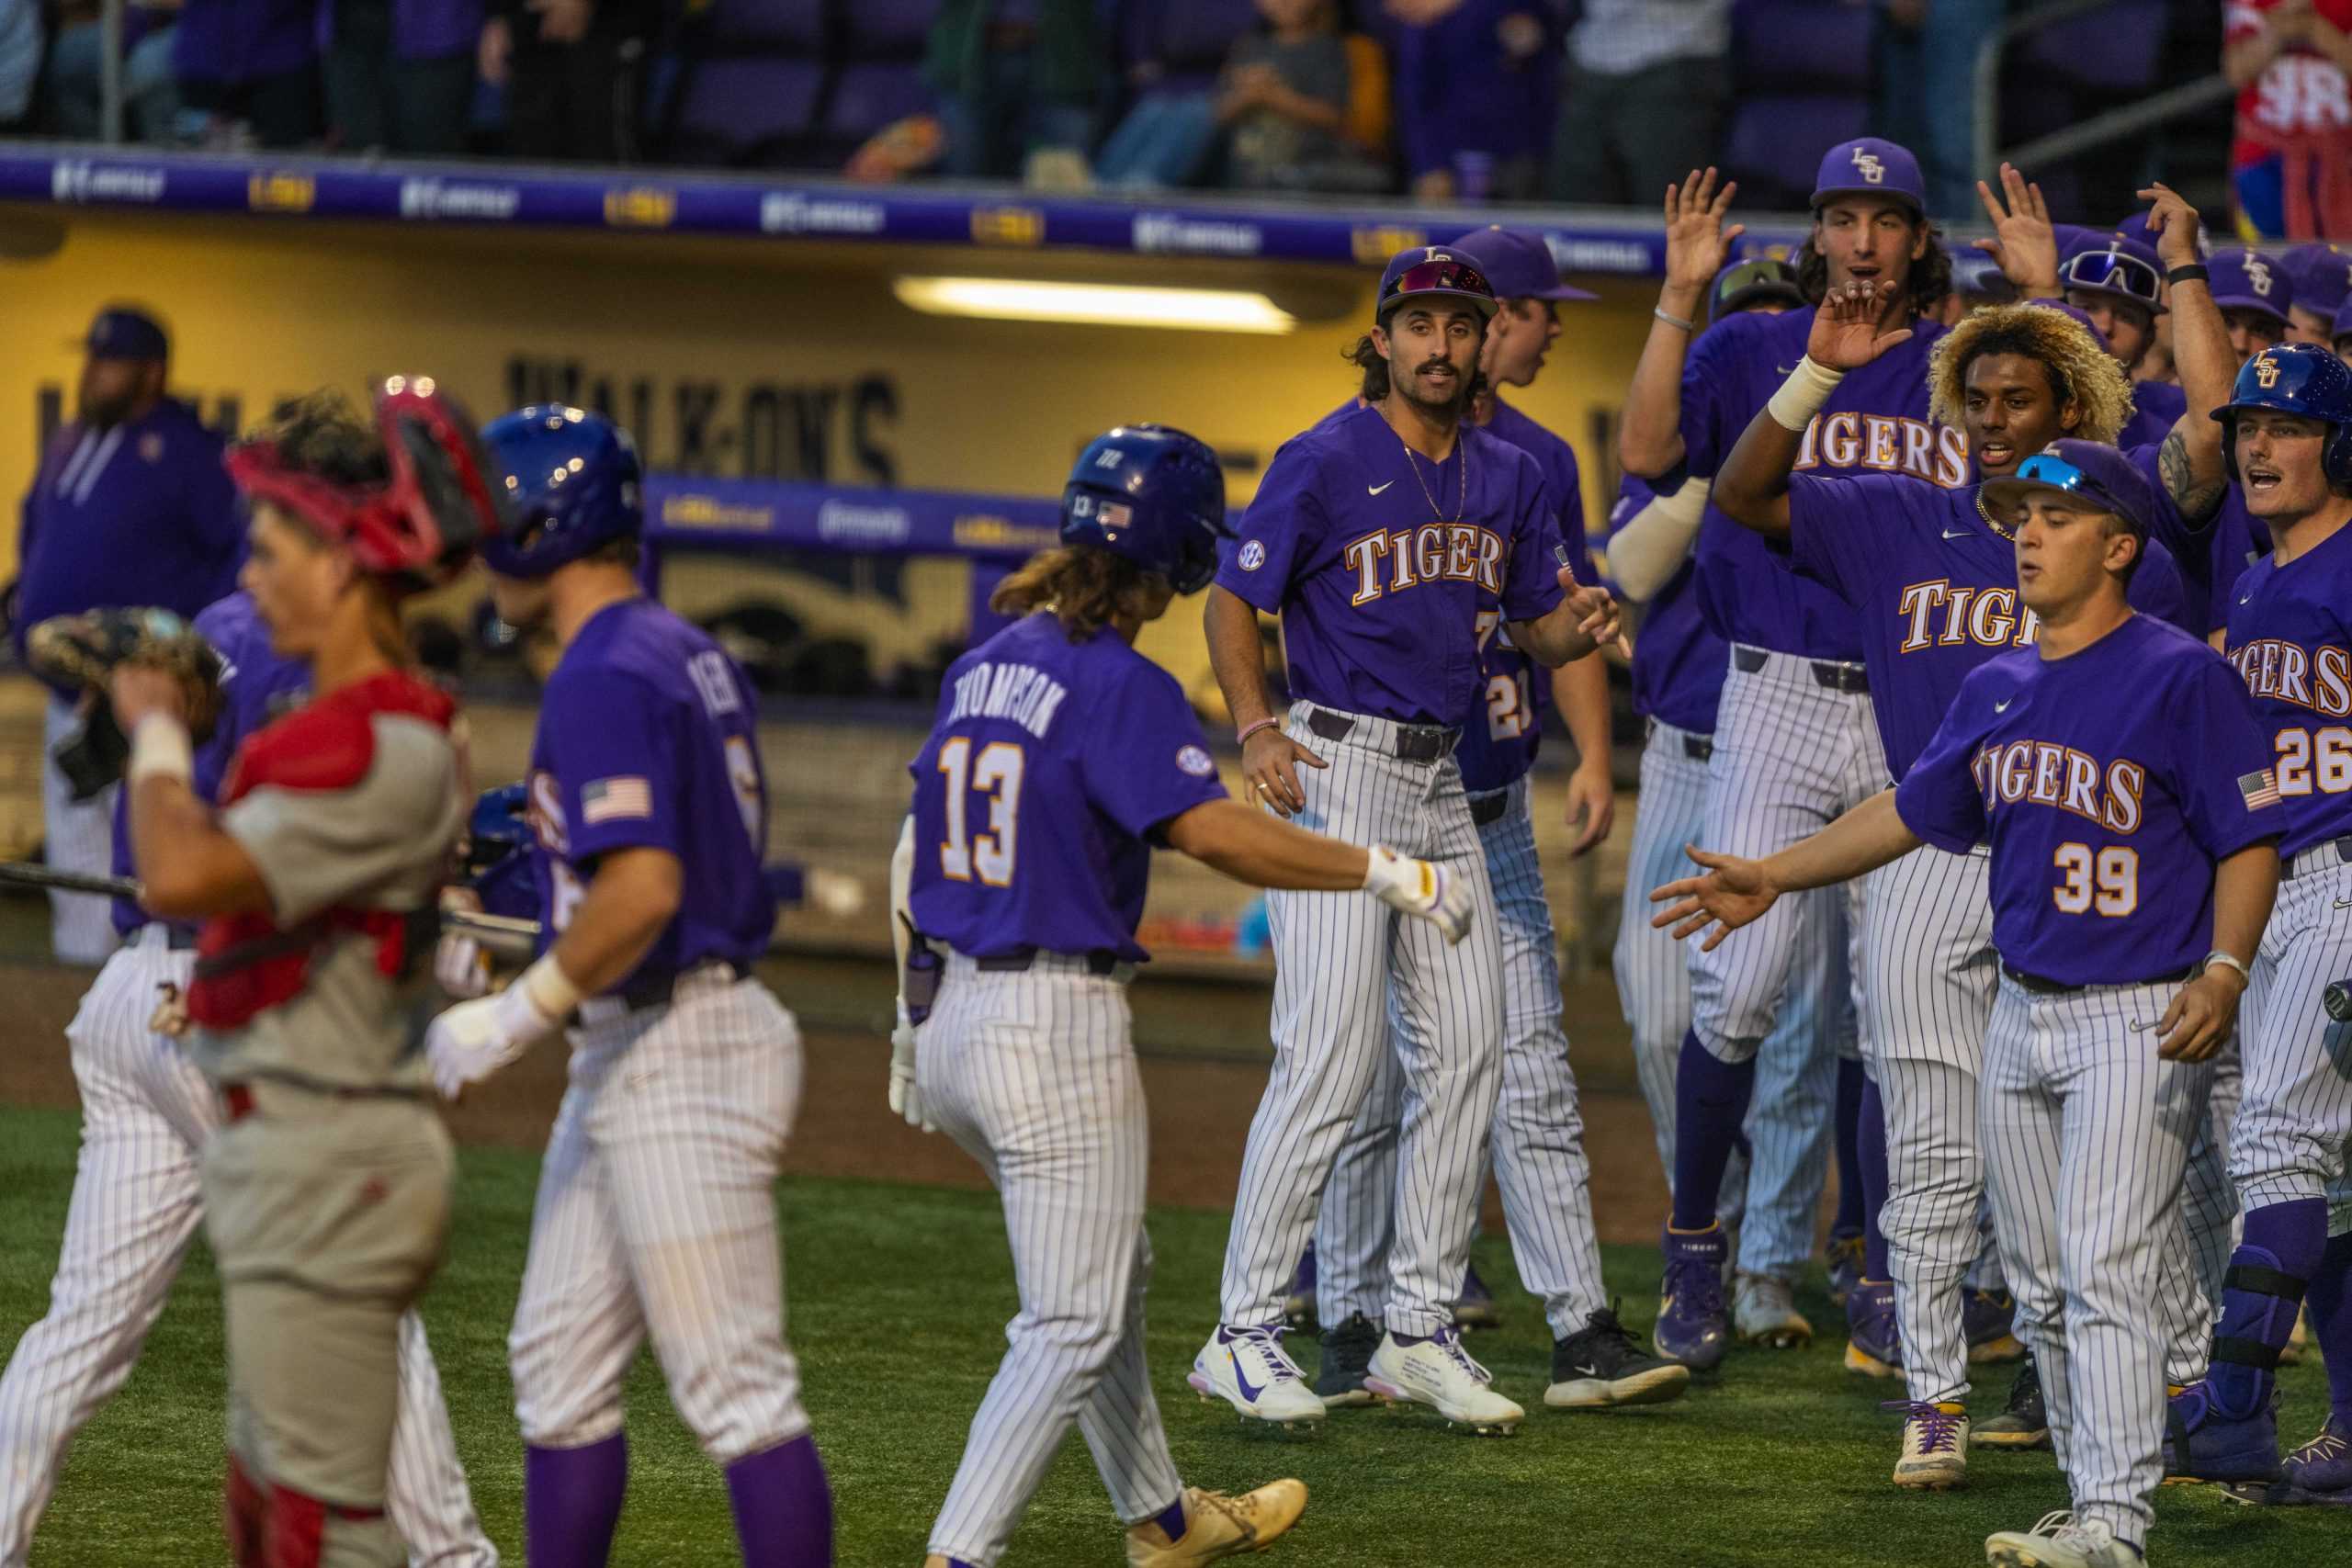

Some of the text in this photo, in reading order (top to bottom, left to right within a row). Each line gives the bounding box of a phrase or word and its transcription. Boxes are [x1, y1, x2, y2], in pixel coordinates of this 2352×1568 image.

[1851, 147, 1885, 184] LSU
[2242, 253, 2273, 295] LSU
[2254, 350, 2280, 389] LSU
[1792, 412, 1970, 489] IGERS
[1345, 522, 1515, 607] TIGER
[2227, 639, 2352, 716] GERS
[2275, 727, 2352, 797] 26
[939, 736, 1024, 887] 13
[2053, 842, 2139, 917] 39
